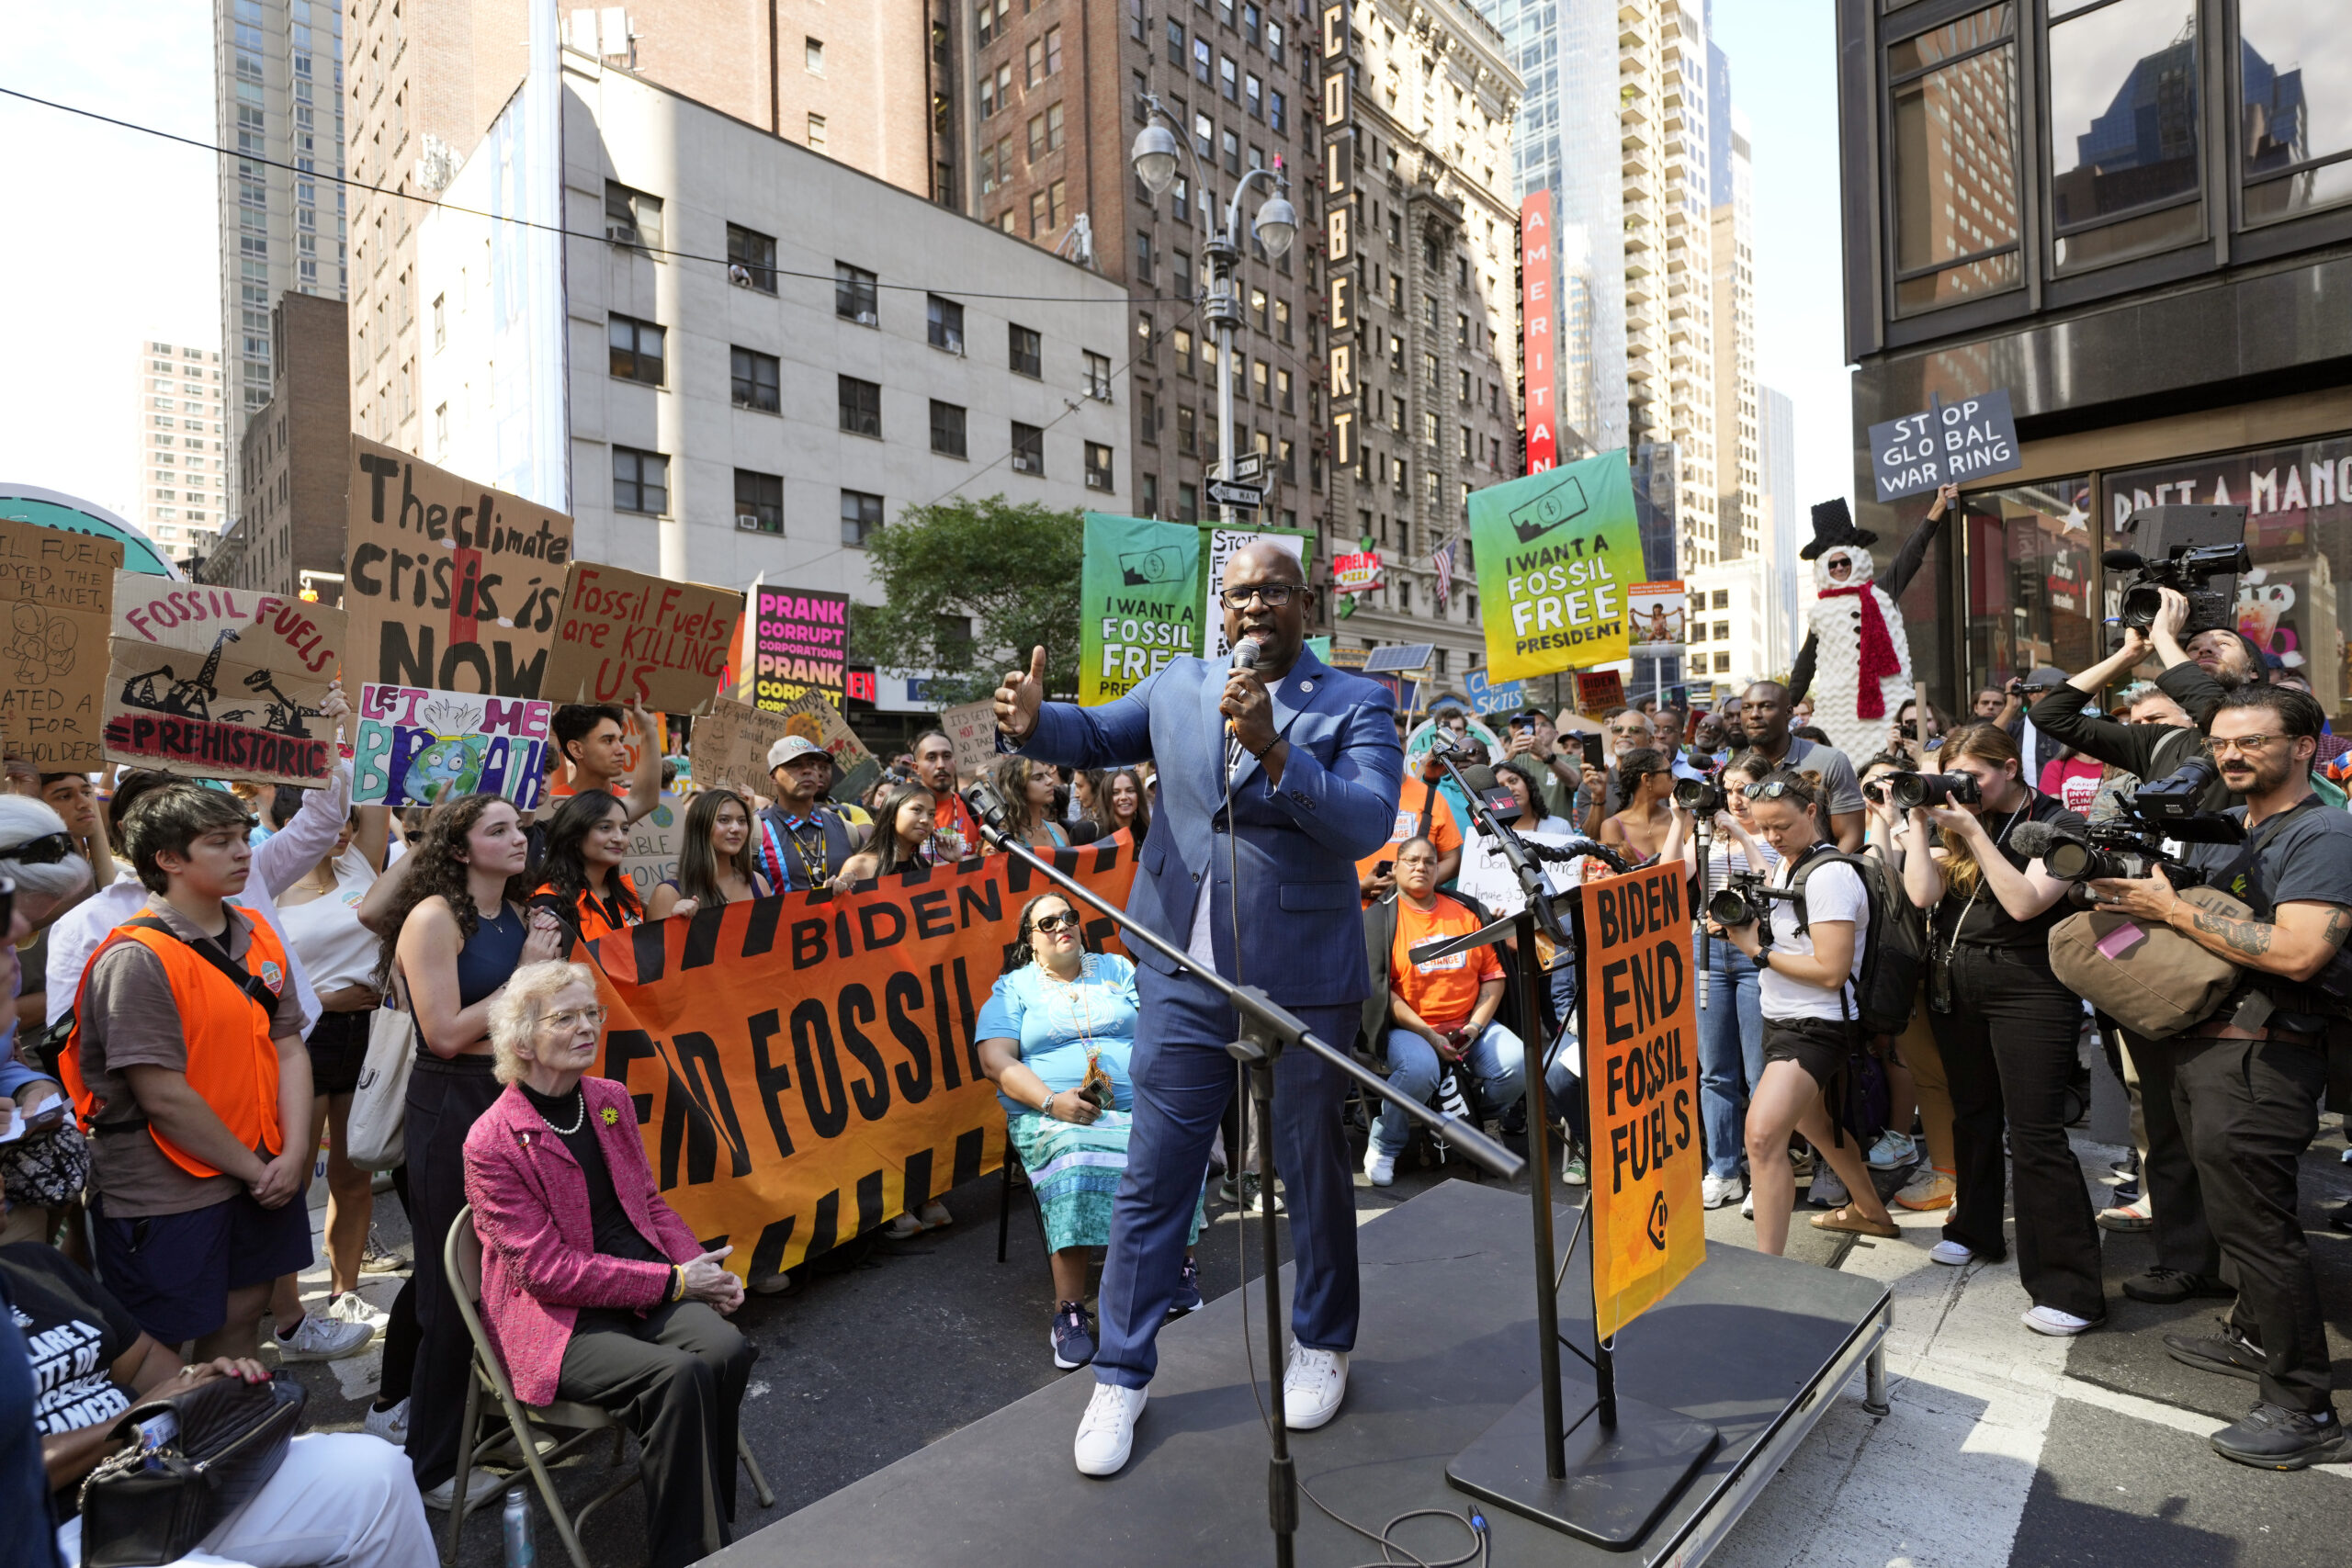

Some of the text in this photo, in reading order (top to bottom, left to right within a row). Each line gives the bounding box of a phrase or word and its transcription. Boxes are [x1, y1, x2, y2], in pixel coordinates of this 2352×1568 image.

[1324, 5, 1351, 464] COLBERT
[1527, 211, 1550, 475] AMERITAN
[359, 453, 447, 541] The
[1215, 486, 1258, 502] ONE WAY
[41, 539, 119, 570] FUELS
[1506, 534, 1609, 576] I WANT A
[0, 563, 102, 585] OYED THE
[1342, 570, 1369, 582] PIZZA
[1507, 556, 1612, 602] FOSSIL
[514, 577, 560, 633] is
[572, 569, 728, 641] Fossil Fuels
[760, 592, 845, 625] PRANK
[1106, 596, 1193, 623] I WANT A
[1511, 582, 1620, 637] FREE
[126, 590, 334, 672] FOSSIL FUELS
[562, 619, 728, 678] are KILLING
[759, 620, 844, 646] CORRUPT
[1102, 617, 1193, 649] FOSSIL
[1516, 621, 1621, 656] PRESIDENT
[379, 621, 548, 701] NOW
[759, 639, 843, 660] CORPORATIONS
[1102, 643, 1193, 680] FRE
[595, 658, 657, 705] US
[758, 653, 843, 687] PRANK
[1583, 676, 1615, 688] BIDEN
[1, 688, 91, 713] ATED A
[361, 686, 550, 740] LET ME
[971, 708, 995, 722] GETTI
[1476, 690, 1523, 716] SKIES
[27, 717, 83, 735] FOR
[958, 736, 994, 752] SO TAKE
[959, 725, 974, 739] HOT
[978, 722, 989, 734] IN
[751, 746, 762, 763] be
[964, 754, 980, 765] ALL
[791, 878, 1003, 970] BIDEN
[1598, 872, 1679, 949] BIDEN
[1603, 940, 1683, 1045] END
[748, 956, 987, 1159] FOSSIL
[1606, 1027, 1687, 1115] FOSSIL
[1611, 1090, 1690, 1194] FUELS
[71, 1320, 102, 1340] A
[74, 1339, 101, 1377] OF
